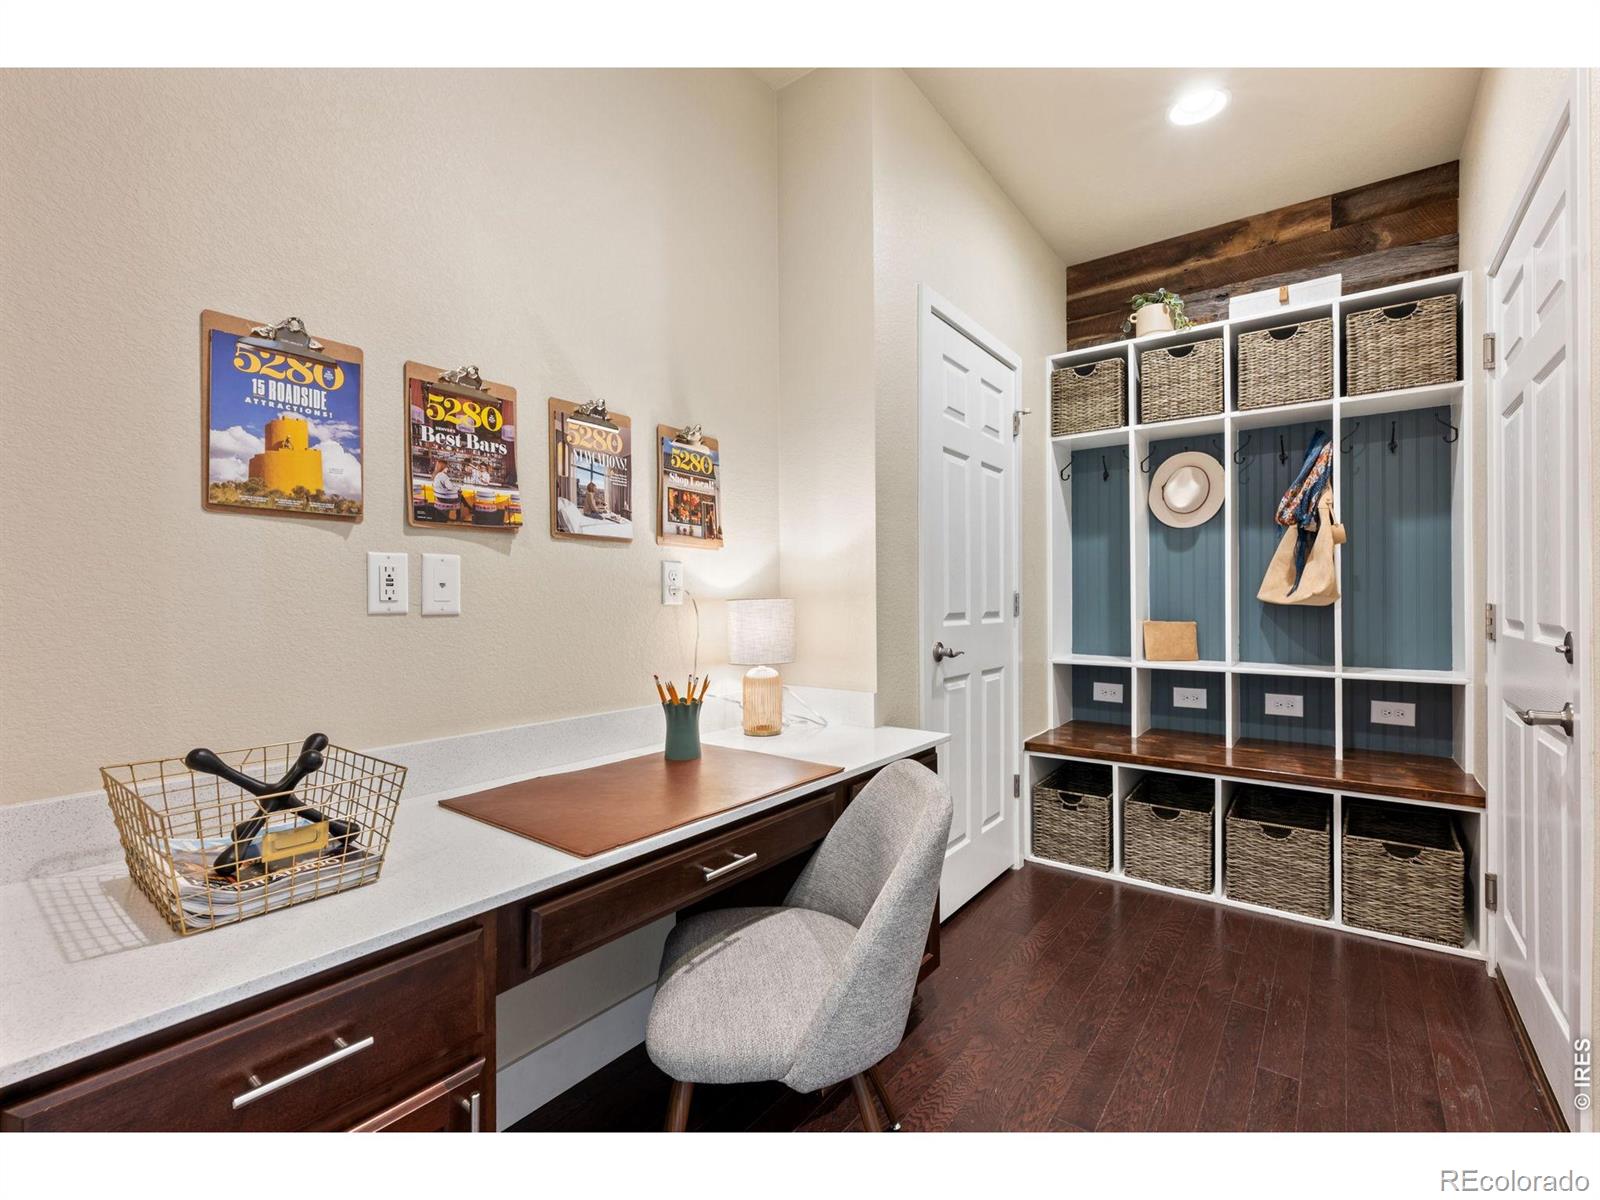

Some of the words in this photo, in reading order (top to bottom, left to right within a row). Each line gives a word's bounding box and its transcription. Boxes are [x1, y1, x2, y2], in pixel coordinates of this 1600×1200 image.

[233, 343, 345, 391] 5280
[245, 396, 334, 419] ATTRACTIONS!
[251, 378, 266, 396] 15
[268, 379, 328, 411] ROADSIDE
[425, 392, 504, 432] 5280
[420, 425, 462, 448] Best
[466, 432, 508, 456] Bars
[566, 422, 624, 455] 5280
[671, 447, 713, 475] 5280
